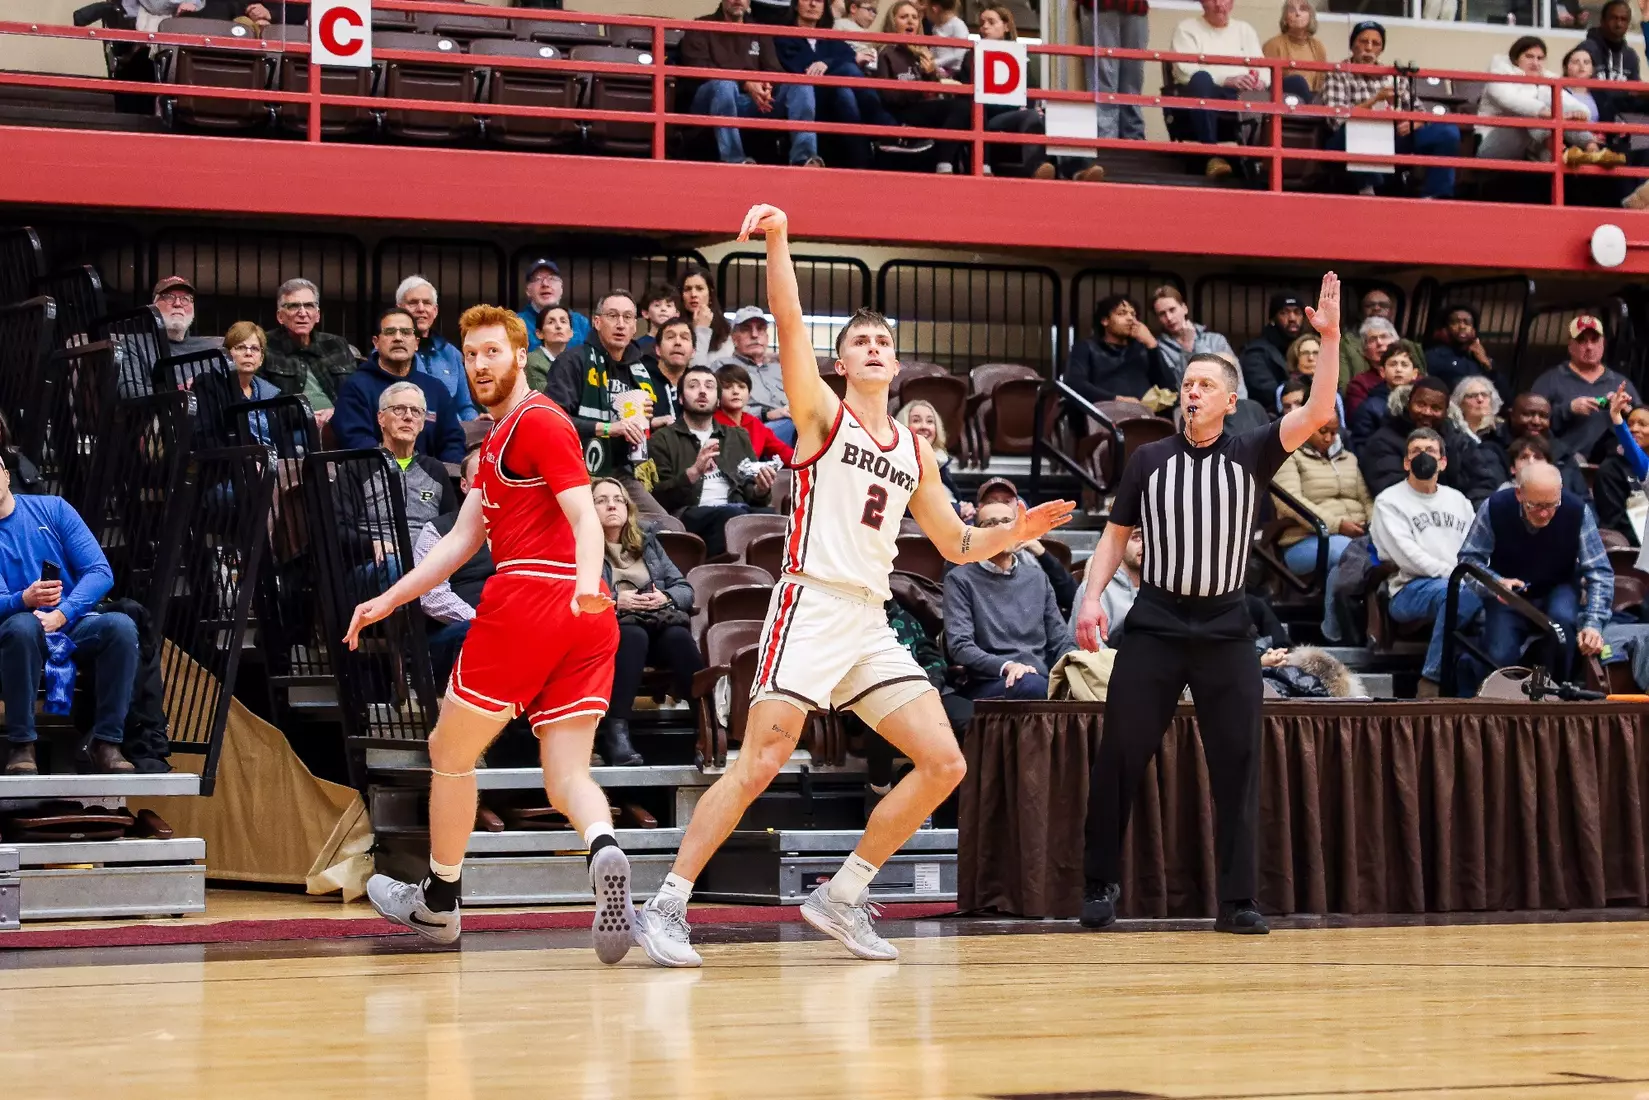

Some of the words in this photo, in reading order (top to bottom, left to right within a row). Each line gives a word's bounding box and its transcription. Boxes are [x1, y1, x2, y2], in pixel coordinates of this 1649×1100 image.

[318, 6, 364, 56] C
[983, 50, 1021, 94] D
[840, 442, 915, 493] BROWN
[860, 483, 888, 531] 2
[1411, 510, 1466, 534] BROWN
